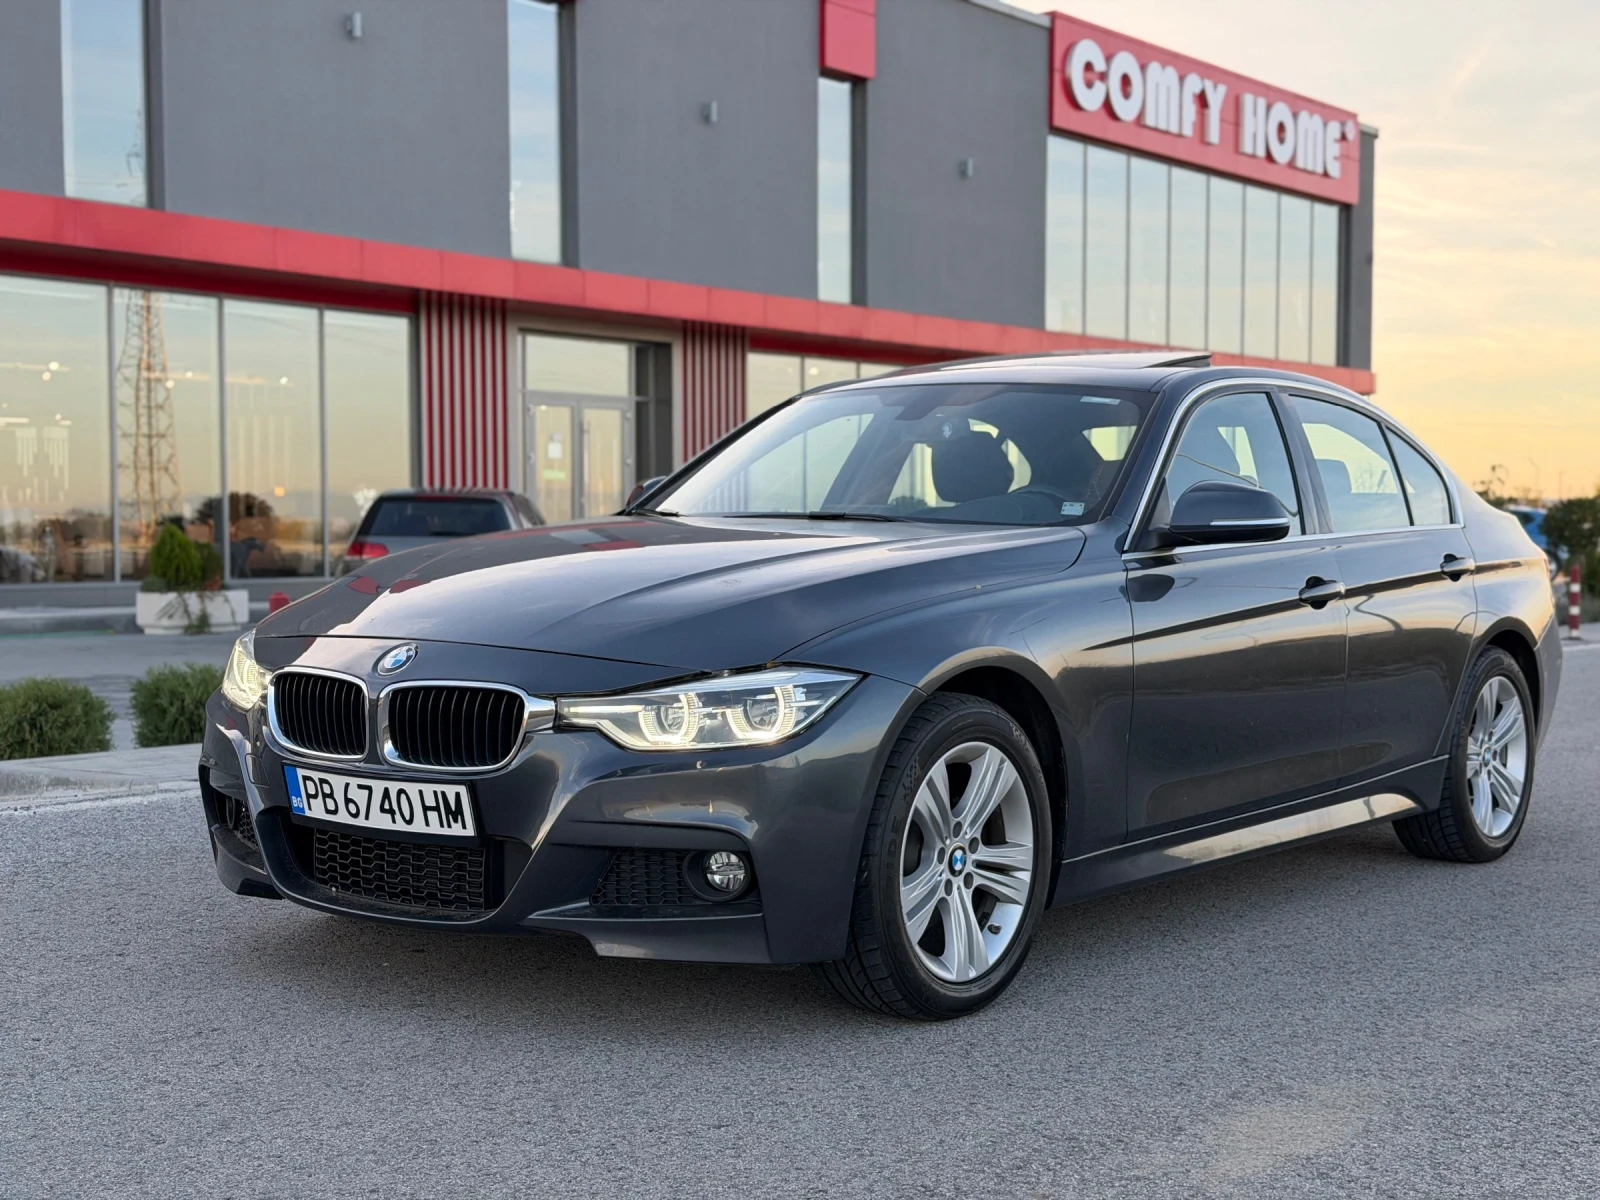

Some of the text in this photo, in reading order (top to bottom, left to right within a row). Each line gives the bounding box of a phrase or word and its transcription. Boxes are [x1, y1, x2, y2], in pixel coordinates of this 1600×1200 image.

[1066, 38, 1342, 179] COMFY HOME
[291, 795, 303, 808] BG
[301, 774, 468, 830] PB 6740 HM
